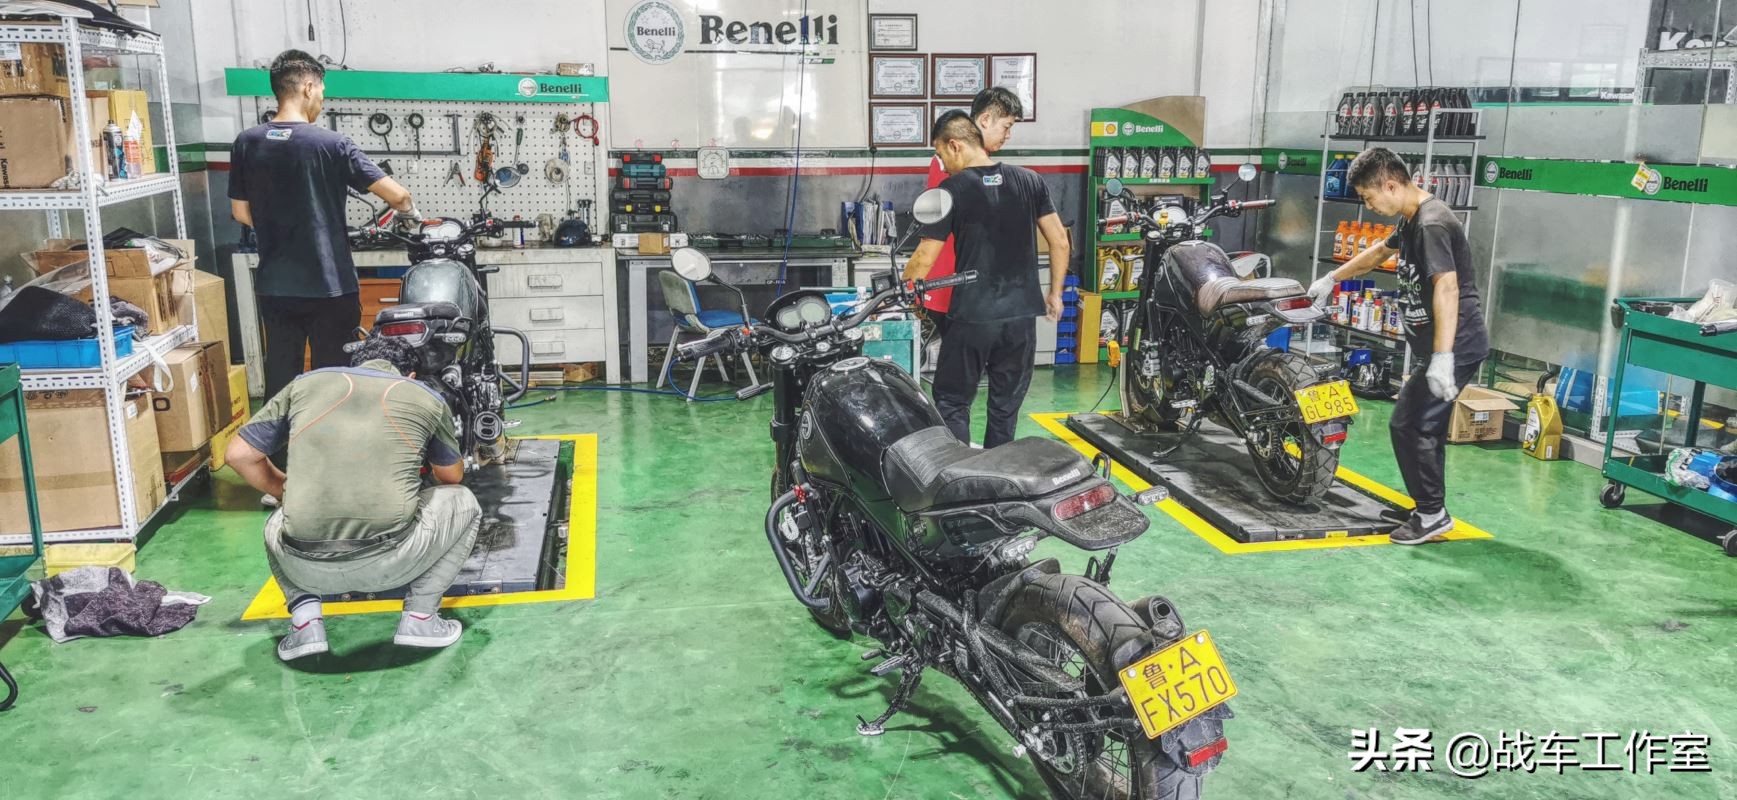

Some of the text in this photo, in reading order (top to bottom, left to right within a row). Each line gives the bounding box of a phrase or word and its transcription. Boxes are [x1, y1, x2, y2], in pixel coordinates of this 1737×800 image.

[636, 26, 676, 37] Benelli
[699, 14, 839, 45] Benelli
[540, 83, 582, 93] Benelli
[1135, 125, 1164, 133] Benelli
[1499, 166, 1533, 181] Benelli
[1663, 176, 1708, 192] Benelli
[1305, 396, 1354, 421] GL985
[1052, 467, 1081, 486] Benelli
[1142, 646, 1202, 690] 鲁·A
[1140, 665, 1229, 732] FX570
